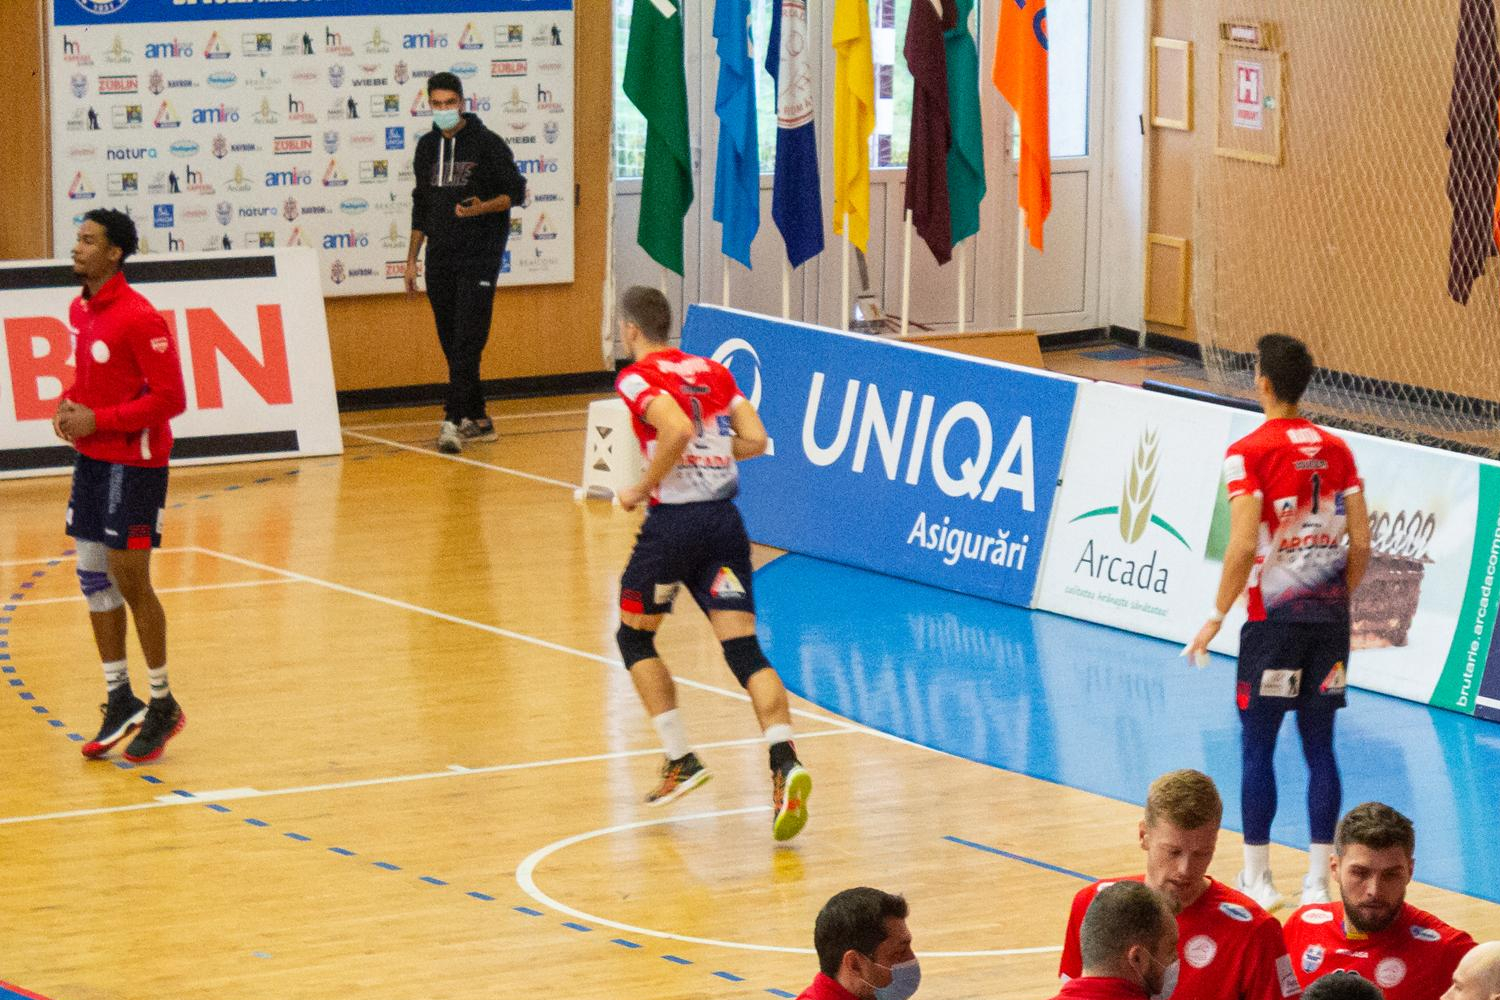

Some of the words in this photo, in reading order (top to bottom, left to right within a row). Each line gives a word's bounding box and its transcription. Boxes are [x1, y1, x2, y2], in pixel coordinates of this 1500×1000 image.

[107, 147, 157, 160] natura
[802, 372, 1036, 512] UNIQA
[907, 511, 1029, 572] Asigurări
[1074, 539, 1169, 594] Arcada
